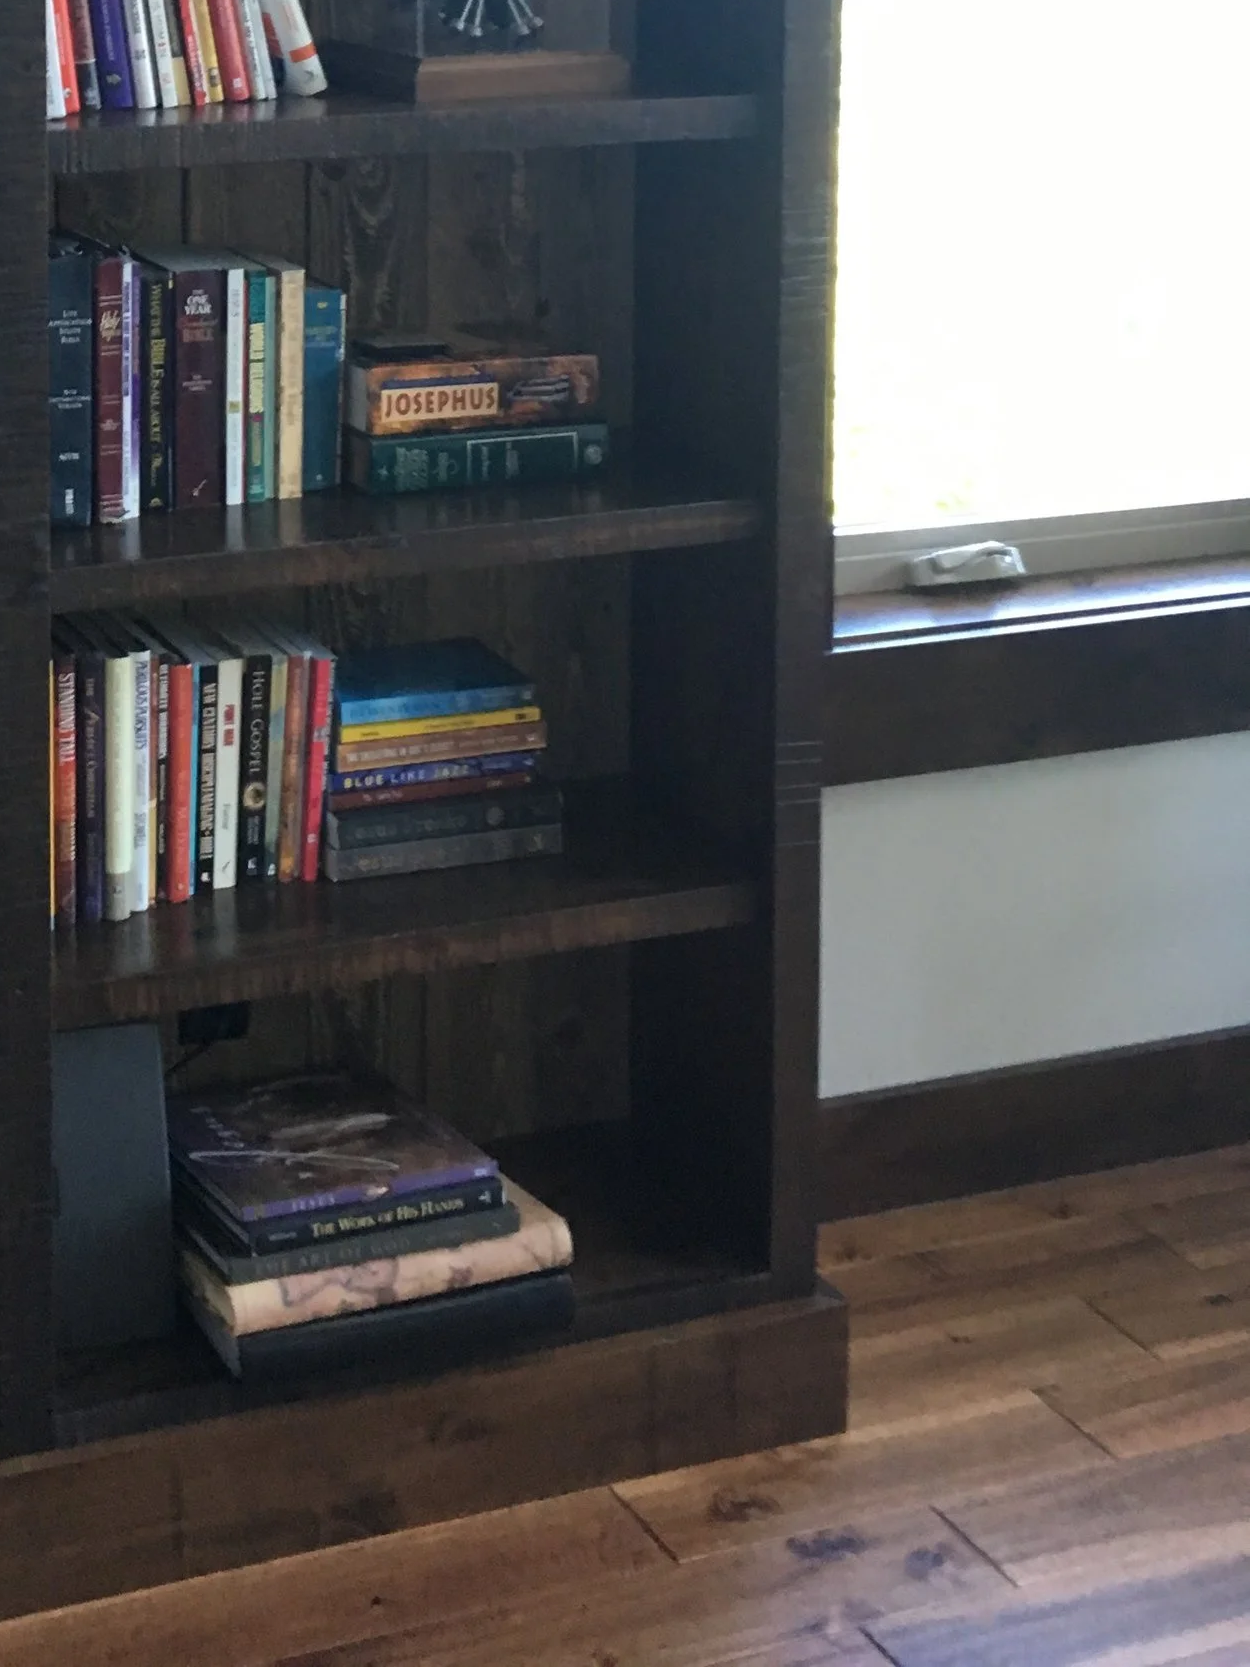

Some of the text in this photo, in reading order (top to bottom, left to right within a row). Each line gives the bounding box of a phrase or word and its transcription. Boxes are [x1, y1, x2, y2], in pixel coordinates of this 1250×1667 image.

[385, 387, 495, 418] JOSEPHUS
[57, 672, 75, 766] STANDING TALL
[133, 706, 148, 751] PURSUITS
[249, 670, 266, 774] HOLE GOSPEL
[344, 765, 470, 789] BLUE LIKE JAZZ
[297, 1251, 330, 1269] ART
